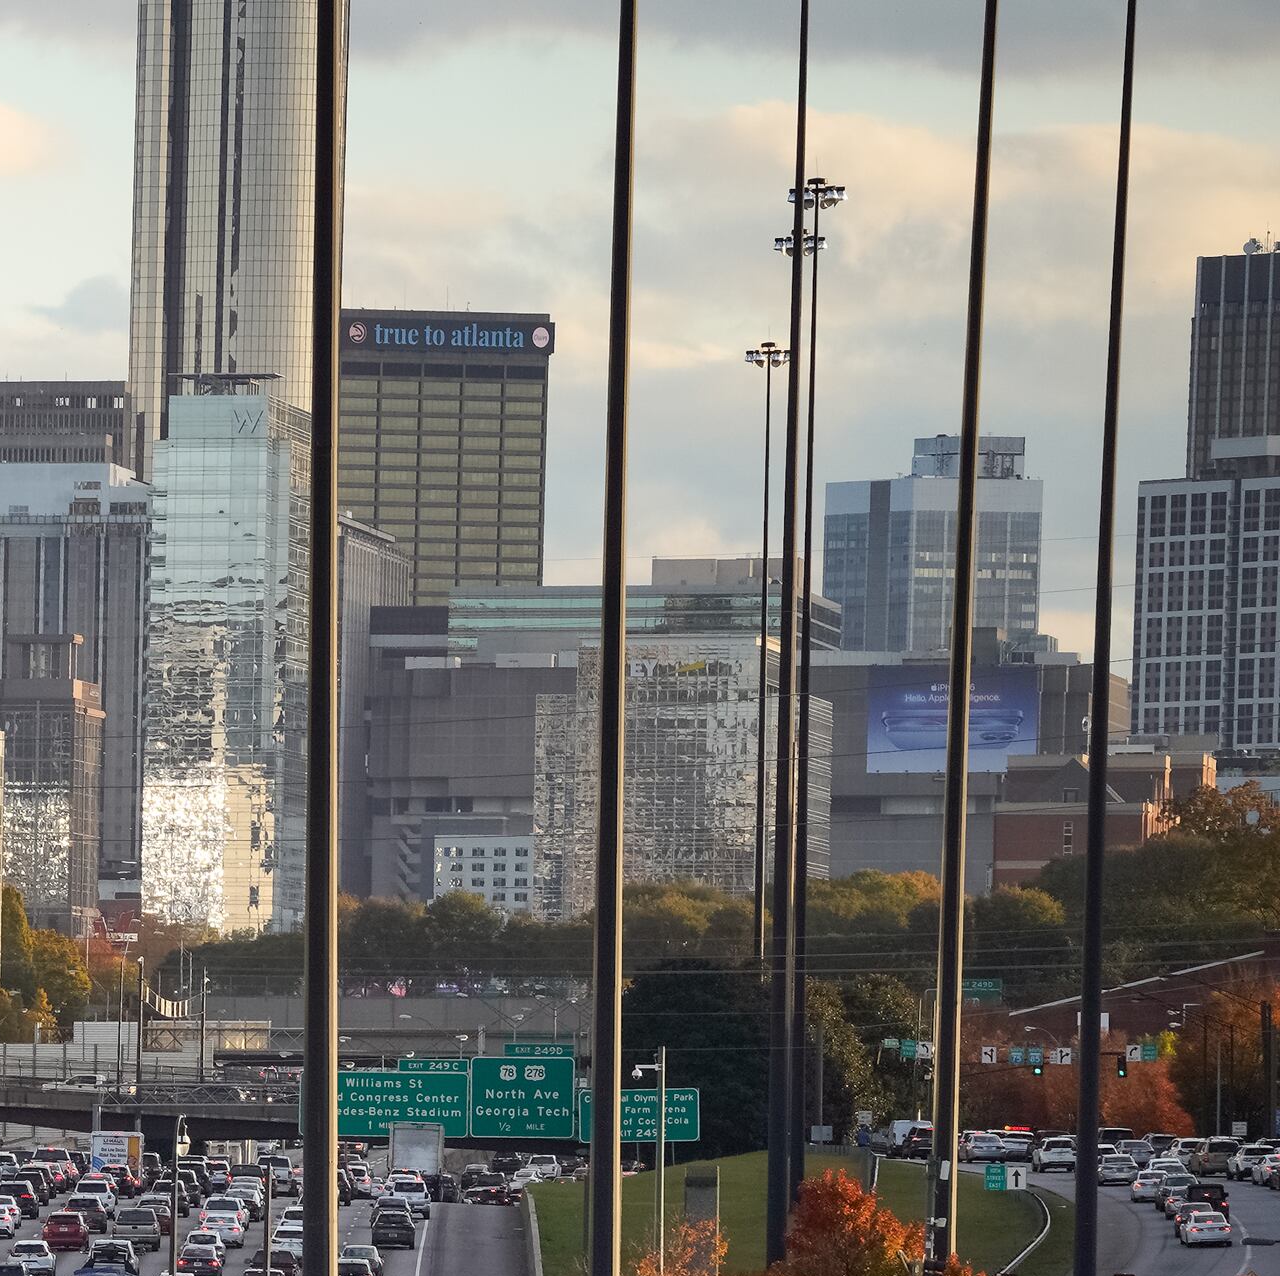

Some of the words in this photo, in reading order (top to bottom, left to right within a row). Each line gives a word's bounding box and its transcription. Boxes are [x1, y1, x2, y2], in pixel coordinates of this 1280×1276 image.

[374, 323, 419, 345] true
[424, 325, 445, 346] to
[451, 323, 524, 348] atlanta
[630, 659, 658, 677] EY
[534, 1046, 563, 1055] 249D
[502, 1068, 514, 1078] 78
[526, 1068, 544, 1078] 278
[346, 1078, 402, 1088] Williams
[409, 1078, 423, 1088] St
[350, 1092, 409, 1104] Congress
[416, 1093, 459, 1103] Center
[485, 1089, 525, 1099] North
[533, 1089, 560, 1099] Ave
[673, 1093, 694, 1101] Park
[337, 1106, 400, 1117] edes-Benz
[407, 1107, 462, 1117] Stadium
[475, 1106, 529, 1119] Georgia
[537, 1106, 569, 1117] Tech
[623, 1117, 633, 1125] of
[526, 1123, 545, 1131] MILE
